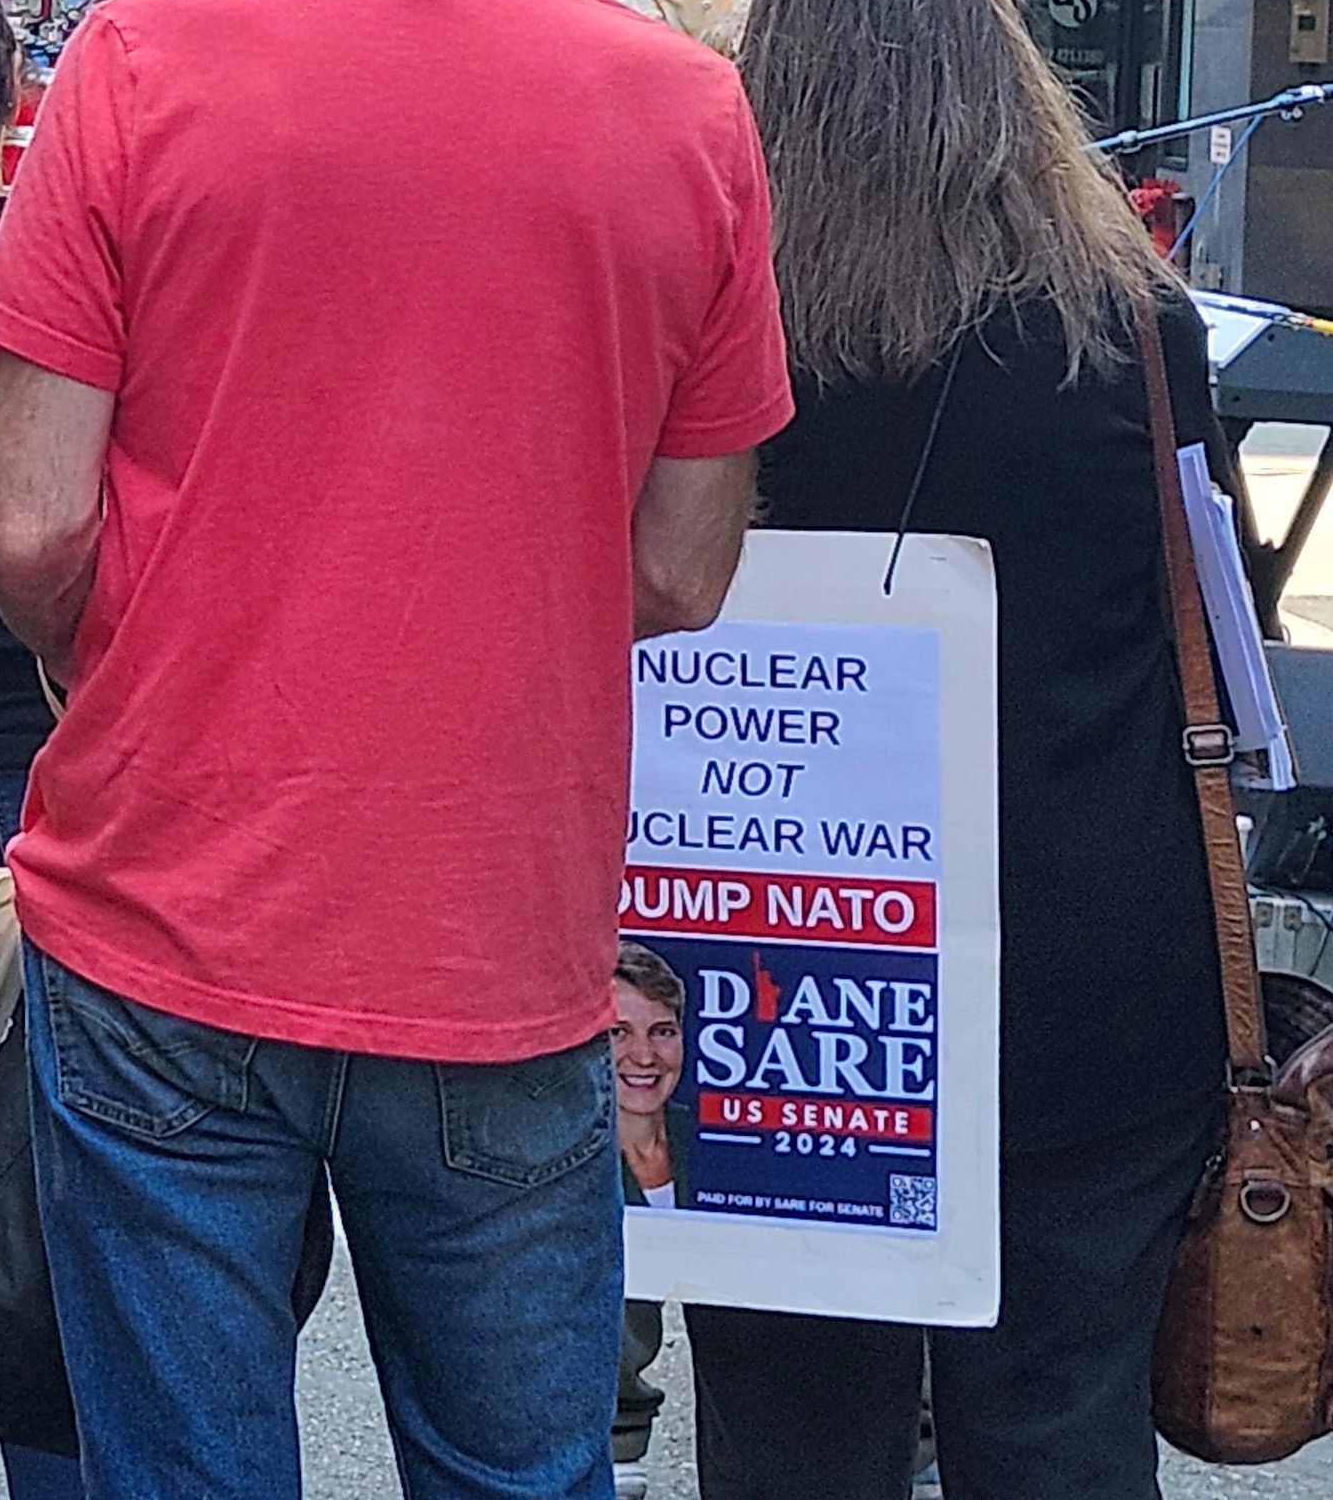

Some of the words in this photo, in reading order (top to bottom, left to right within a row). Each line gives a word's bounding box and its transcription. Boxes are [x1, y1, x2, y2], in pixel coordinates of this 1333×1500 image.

[637, 648, 868, 692] NUCLEAR
[664, 703, 841, 746] POWER
[701, 760, 805, 798] NOT
[626, 810, 805, 855] CLEAR
[821, 820, 934, 862] WAR
[767, 884, 915, 933] NATO
[696, 1022, 934, 1100] SARE
[723, 1097, 763, 1124] US
[782, 1102, 909, 1135] SENATE
[774, 1131, 856, 1158] 2024
[696, 1190, 726, 1205] PAID
[727, 1193, 753, 1208] FOR
[755, 1195, 772, 1209] BY
[774, 1197, 807, 1212] SARE
[808, 1200, 834, 1214] FOR
[836, 1202, 885, 1219] SENATE
